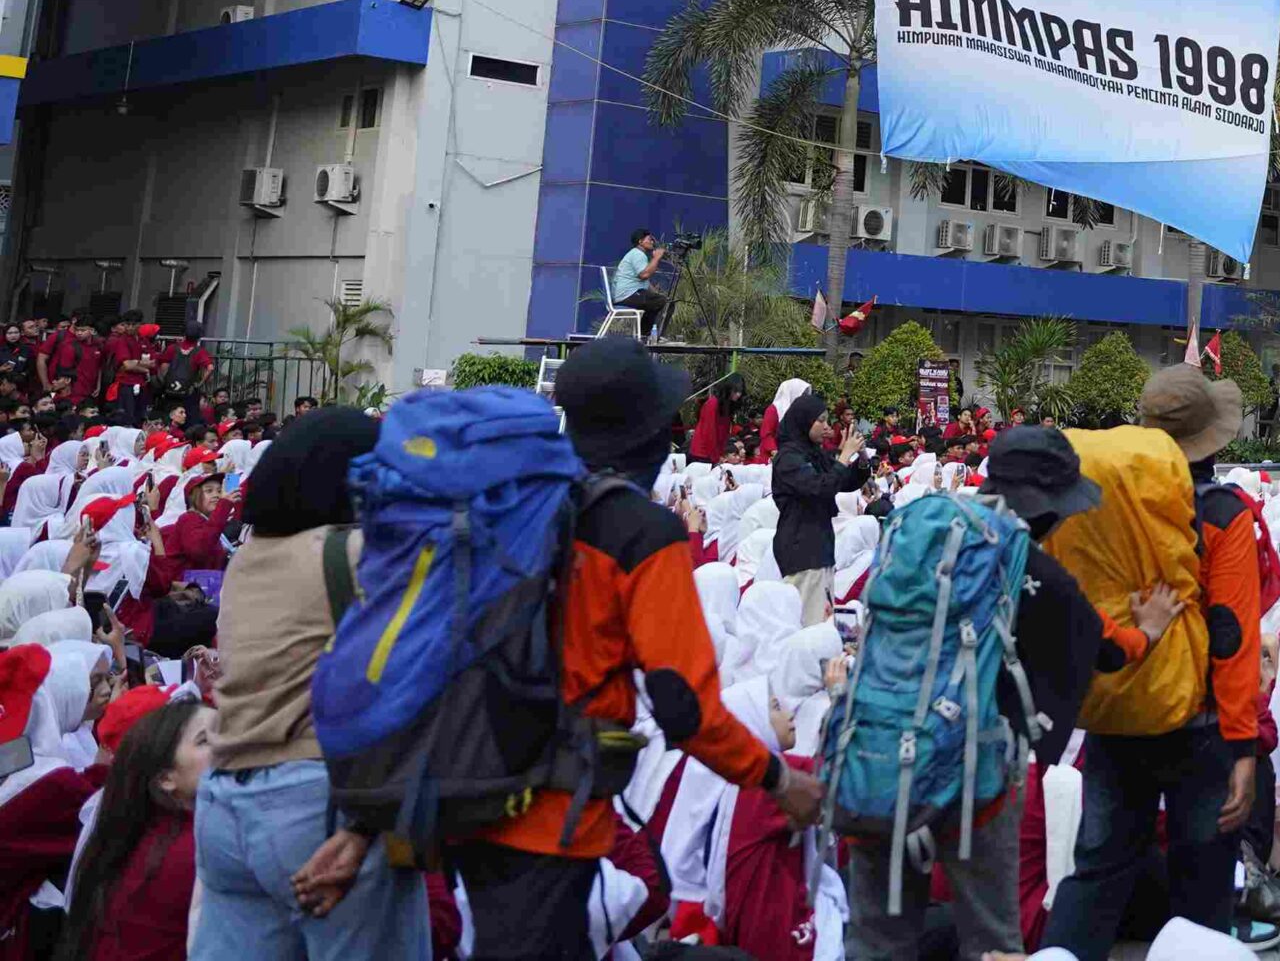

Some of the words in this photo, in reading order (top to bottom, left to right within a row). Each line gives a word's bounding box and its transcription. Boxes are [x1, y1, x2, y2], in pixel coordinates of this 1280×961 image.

[897, 30, 963, 48] HIMPUNAN
[965, 36, 1032, 66] MAHASISWA
[1034, 55, 1124, 95] MUHAMMADIYAH
[1127, 84, 1179, 109] PENCINTA
[1181, 96, 1213, 119] ALAM
[1215, 106, 1266, 135] SIDOARJO
[1151, 33, 1269, 116] 1998
